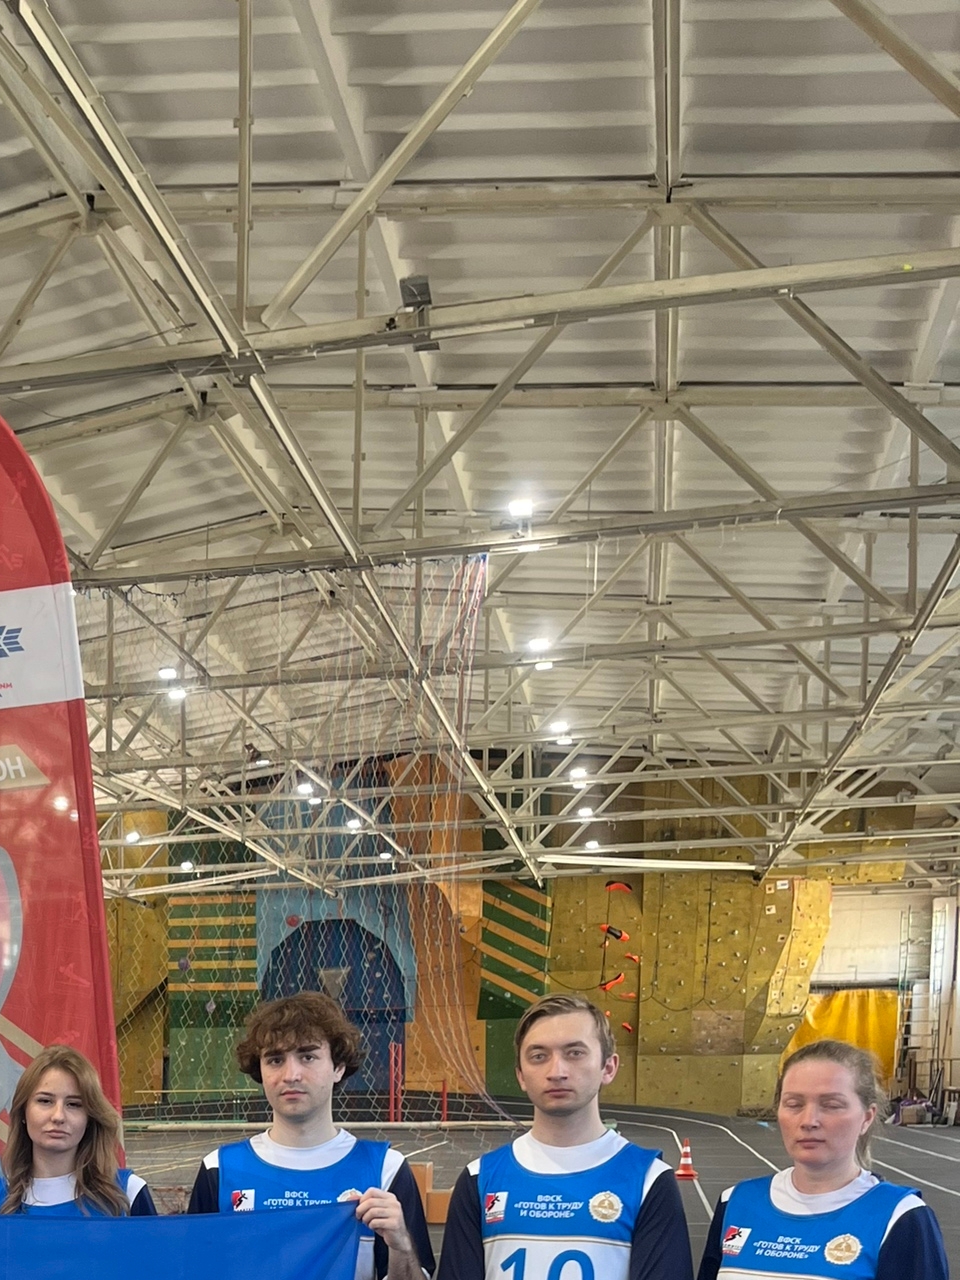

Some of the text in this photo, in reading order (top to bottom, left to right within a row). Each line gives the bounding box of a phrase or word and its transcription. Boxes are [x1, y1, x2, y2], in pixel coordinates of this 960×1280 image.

[263, 1198, 294, 1206] «ГОТОВ
[514, 1201, 584, 1210] «ГОТОВ К ТРУДУ
[528, 1210, 575, 1218] ОБОРОНЕ»
[777, 1235, 802, 1244] ВФСК
[753, 1240, 784, 1250] «ГОТОВ
[793, 1244, 821, 1253] ТРУДУ
[755, 1248, 809, 1259] И ОБОРОНЕ»
